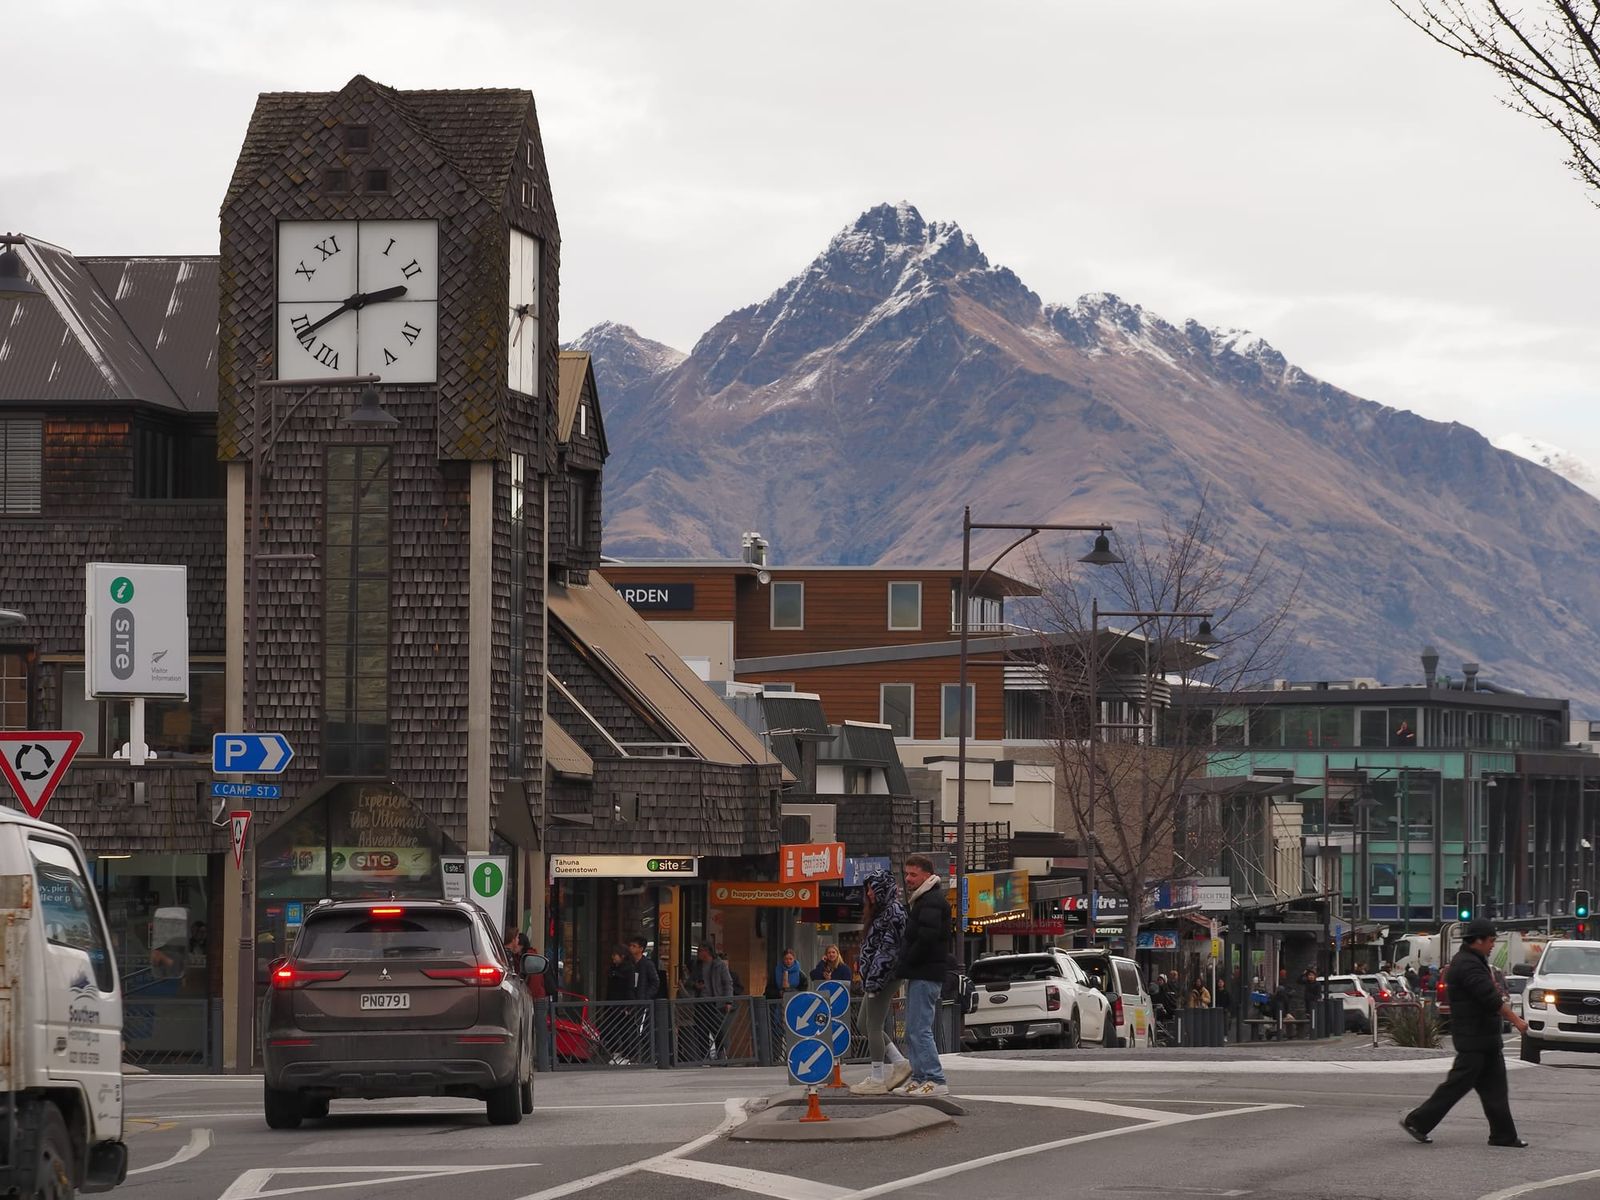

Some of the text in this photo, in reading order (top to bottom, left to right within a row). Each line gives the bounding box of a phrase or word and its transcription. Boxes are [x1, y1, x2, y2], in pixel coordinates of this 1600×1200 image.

[294, 260, 317, 282] X
[290, 313, 317, 352] VII
[151, 666, 168, 674] Visitor
[225, 739, 248, 768] P
[222, 784, 270, 796] CAMP ST
[371, 808, 427, 829] Ultimate
[358, 829, 419, 849] Adventure
[659, 861, 679, 870] site
[1076, 895, 1117, 909] cetre
[1039, 920, 1063, 928] GIFTS
[362, 994, 407, 1008] PNQ791
